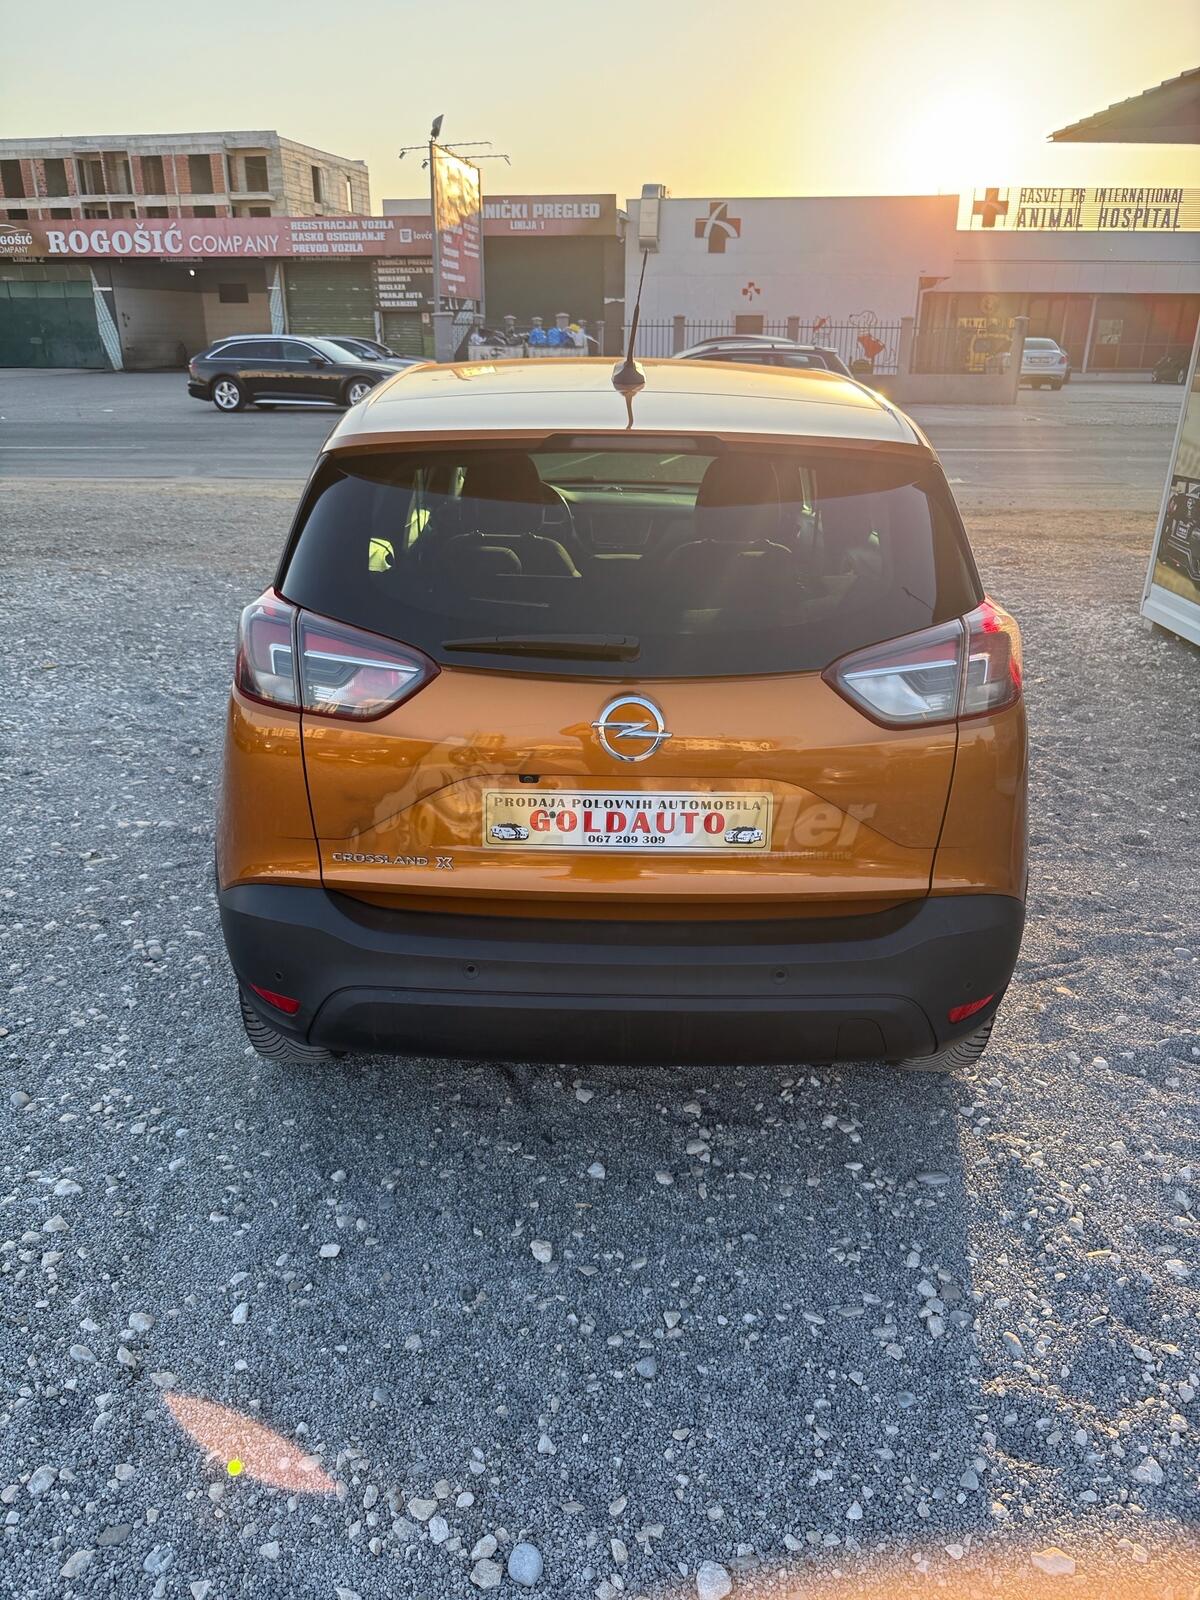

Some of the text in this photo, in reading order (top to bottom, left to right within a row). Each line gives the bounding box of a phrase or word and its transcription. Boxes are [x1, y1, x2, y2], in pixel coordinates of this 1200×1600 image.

[1095, 188, 1184, 203] INTERNATIONAL
[532, 203, 600, 218] PREGLED
[290, 220, 395, 230] REGISTRACIJA VOZILA
[1017, 208, 1181, 228] ANIMAL HOSPITAL
[540, 221, 545, 230] 1
[46, 222, 279, 253] ROGOŠIĆ COMPANY
[291, 231, 386, 242] KASKO OSIGURANJE
[0, 246, 29, 254] OMPANY
[292, 243, 364, 253] PREVOD VOZILA
[494, 797, 761, 811] PRODAJA POLOVNIH AUTOMOBILA
[529, 809, 725, 835] GOLDAUTO
[588, 835, 665, 844] 067 209 309
[332, 852, 455, 870] CROSSLAND X
